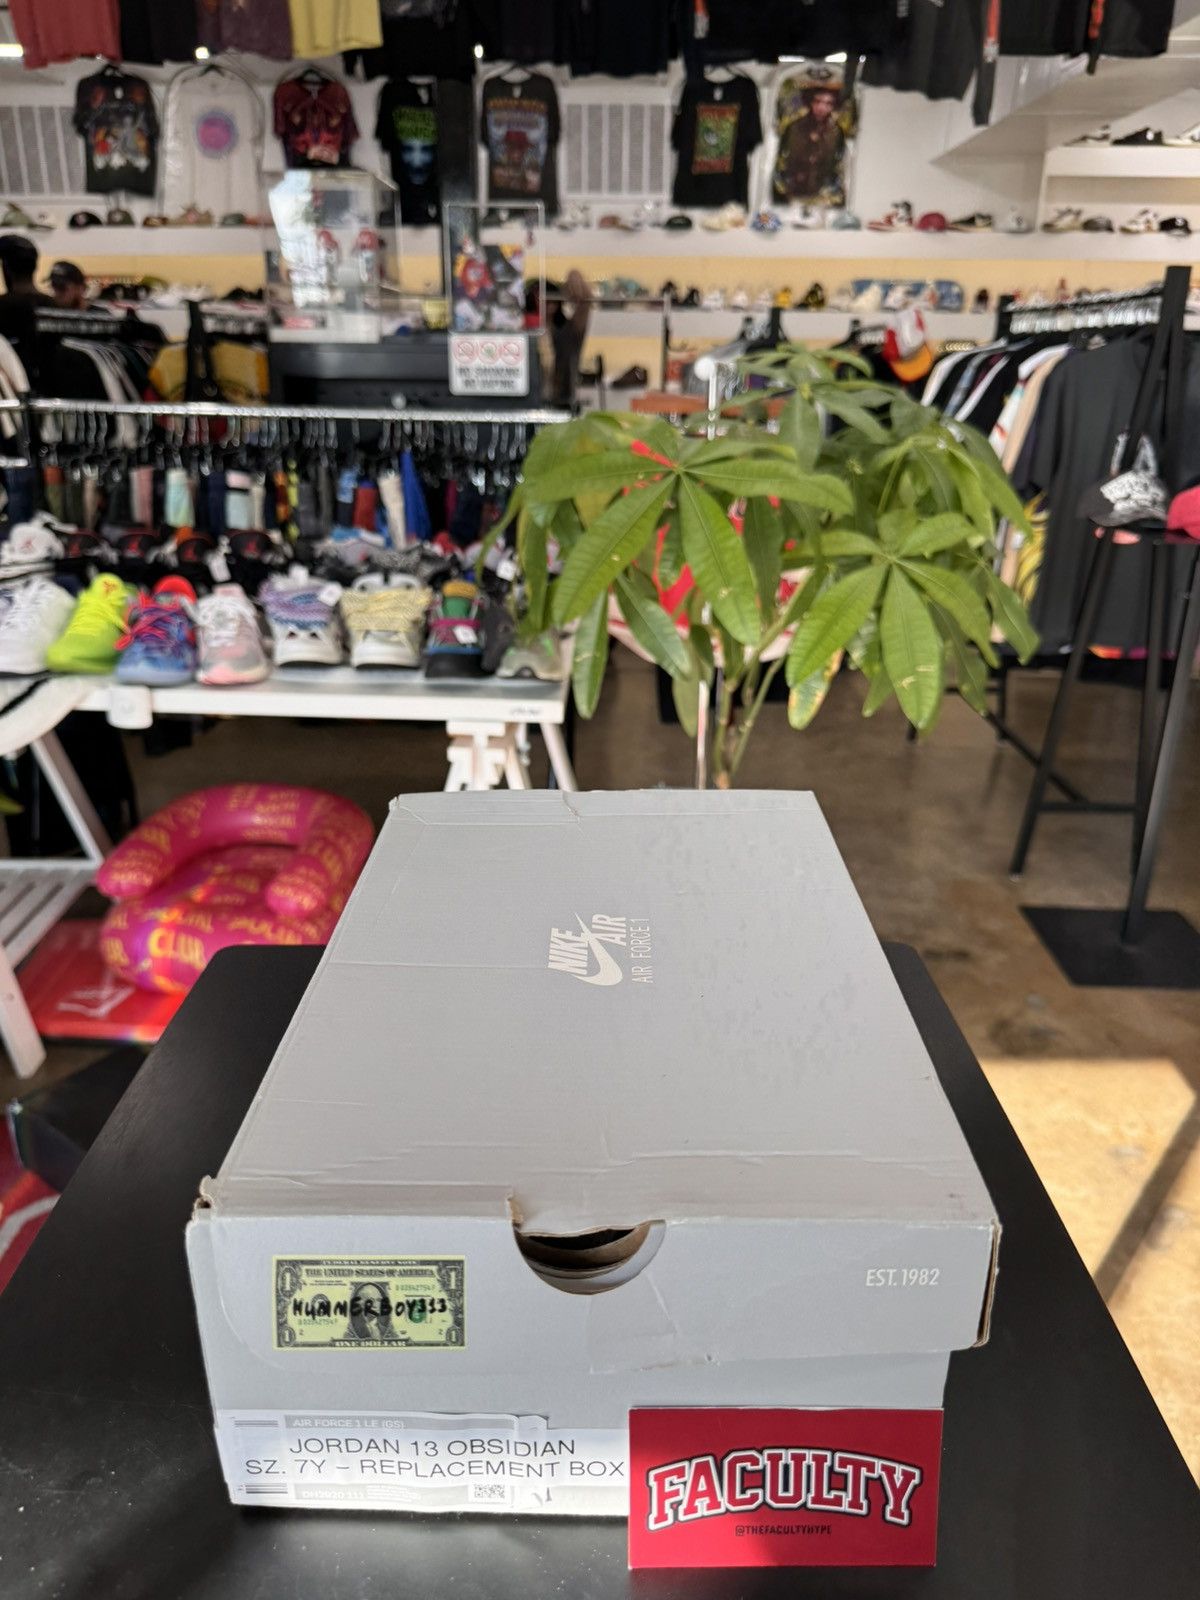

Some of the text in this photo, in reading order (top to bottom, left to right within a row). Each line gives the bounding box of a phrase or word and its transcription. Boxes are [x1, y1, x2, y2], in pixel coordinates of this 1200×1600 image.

[547, 913, 627, 976] NIKE AIR
[630, 926, 652, 959] FORCE
[631, 965, 654, 984] AIR
[291, 1419, 312, 1428] AIR
[314, 1419, 355, 1428] FORCE
[364, 1420, 379, 1428] LE
[289, 1438, 575, 1457] JORDAN 13 OBSIDIAN
[245, 1460, 286, 1475] SZ.
[294, 1459, 326, 1474] 7Y
[360, 1459, 561, 1478] REPLACEMENT
[570, 1460, 625, 1477] BOX
[648, 1448, 921, 1531] FACULTY
[735, 1524, 832, 1537] @THEFACULTYHYPE
